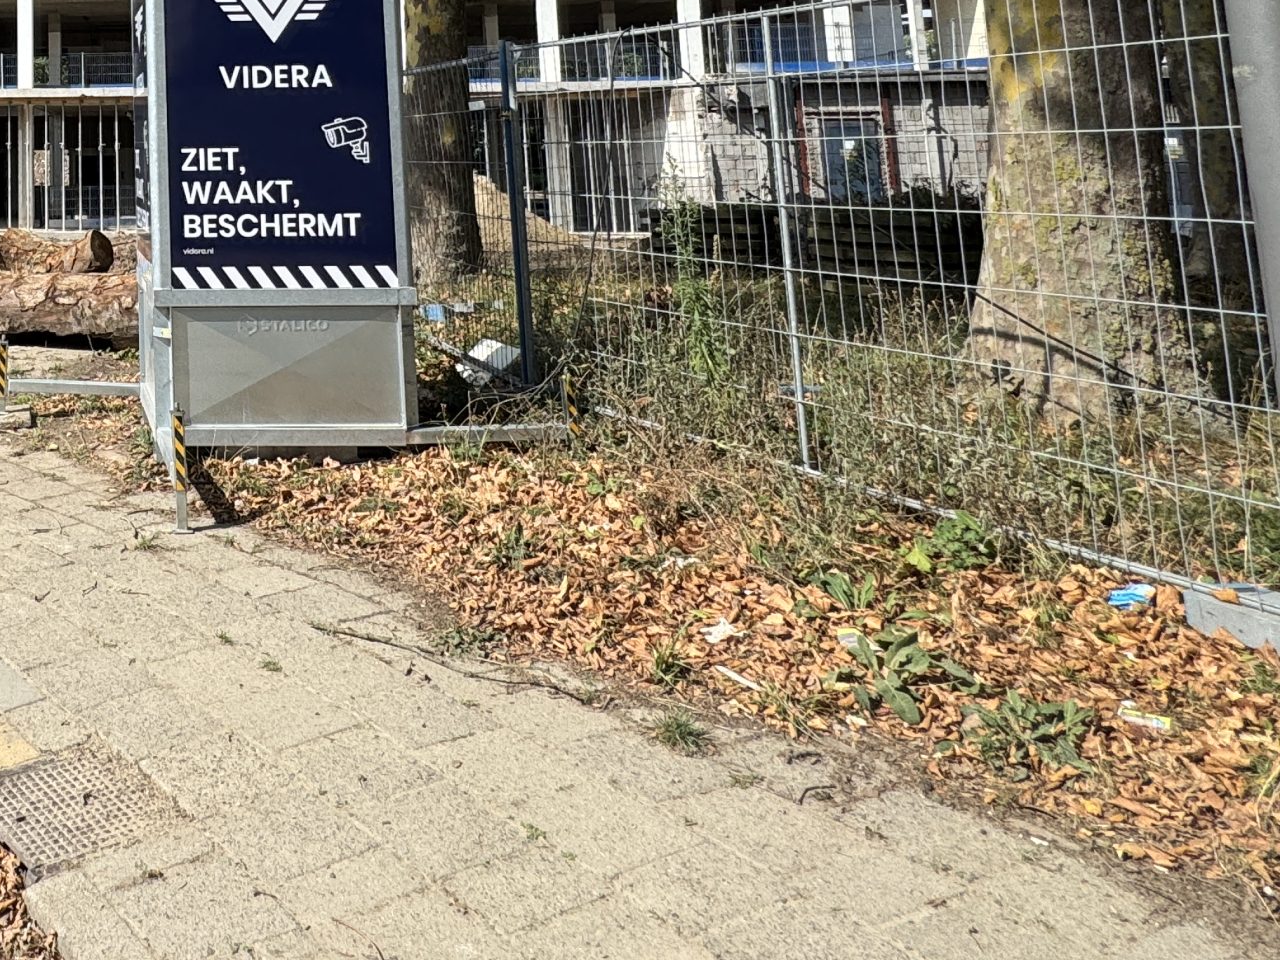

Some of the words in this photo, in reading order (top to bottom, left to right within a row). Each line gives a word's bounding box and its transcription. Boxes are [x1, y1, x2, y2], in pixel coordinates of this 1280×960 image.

[219, 63, 333, 89] VIDERA
[180, 147, 247, 176] ZIET,
[181, 180, 300, 208] WAAKT,
[182, 212, 362, 238] BESCHERMT
[260, 319, 330, 332] STALICO
